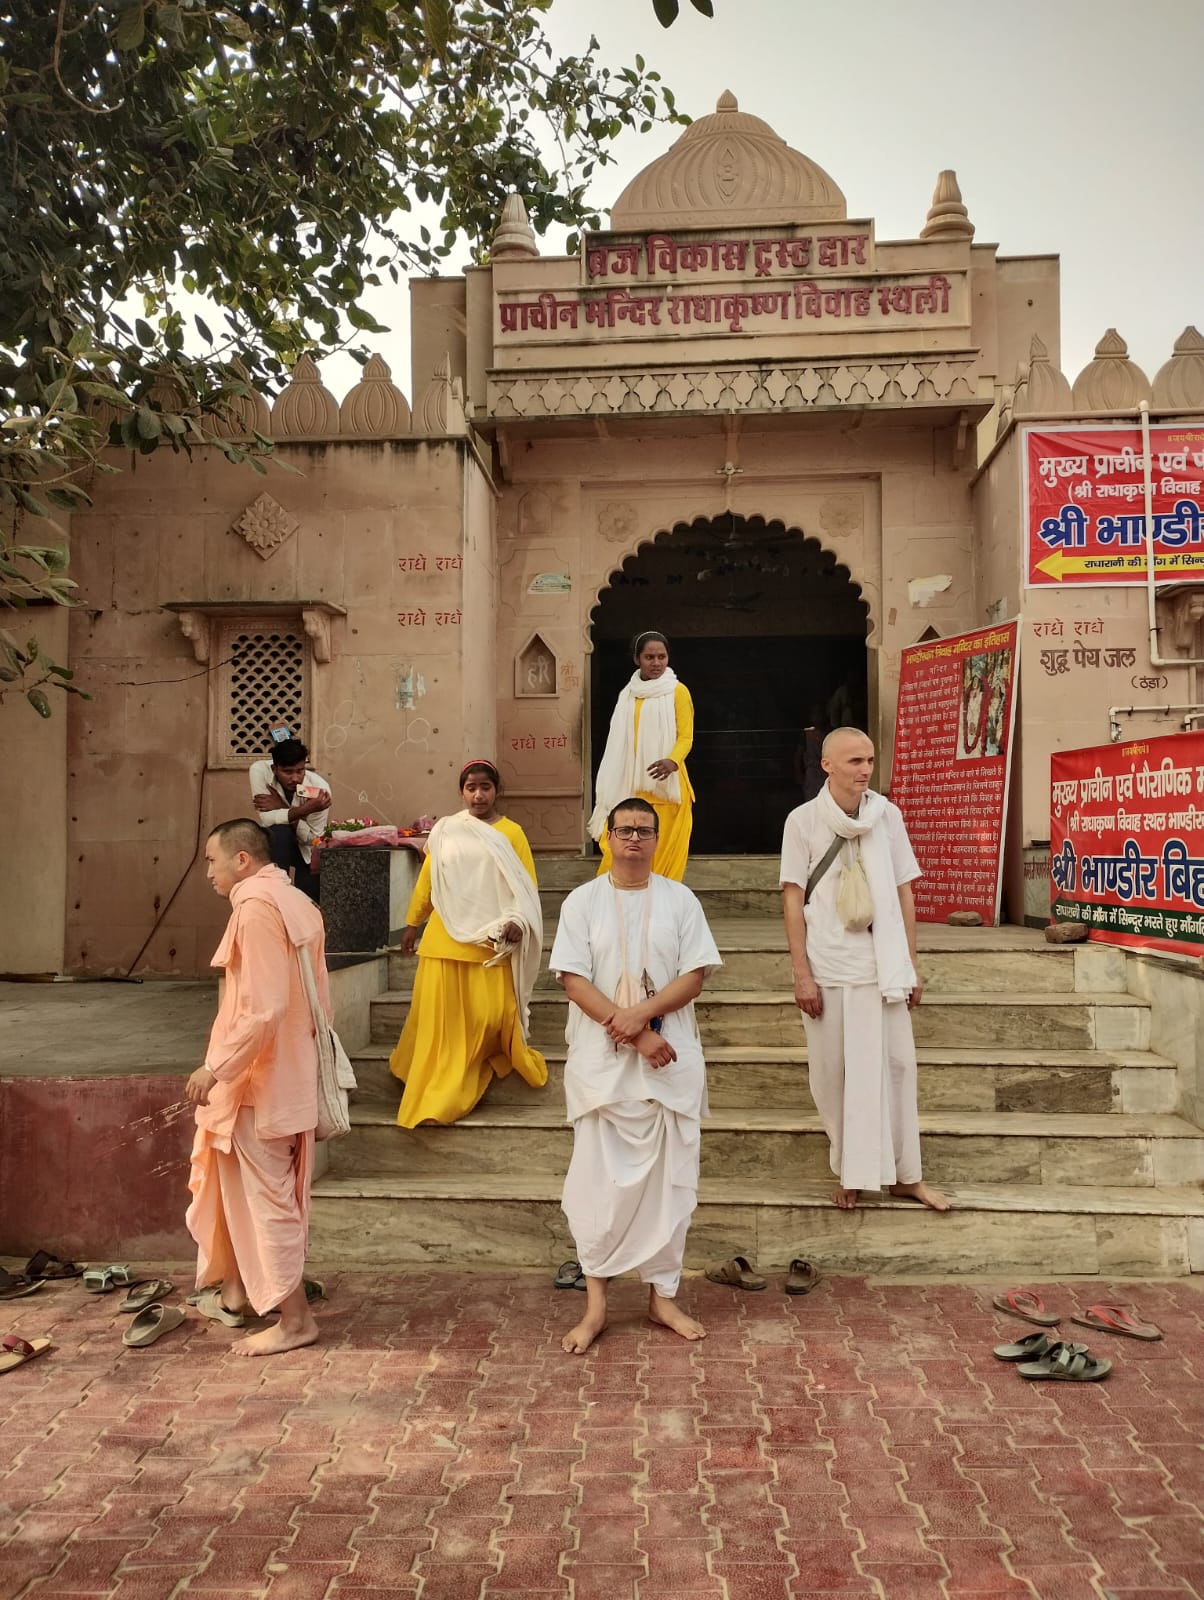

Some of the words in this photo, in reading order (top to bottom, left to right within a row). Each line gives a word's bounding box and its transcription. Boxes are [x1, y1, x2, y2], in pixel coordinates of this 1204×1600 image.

[588, 244, 640, 278] ब्रज
[648, 233, 748, 274] विकास
[753, 237, 811, 277] ट्रस्ट
[818, 234, 869, 267] द्वार
[500, 293, 578, 333] प्राचीन
[585, 289, 663, 328] मन्दिर
[667, 291, 792, 332] राधाकृष्ण
[794, 281, 873, 319] विवाह
[878, 276, 952, 315] स्थली
[1039, 456, 1089, 488] मुख्य
[1158, 446, 1189, 473] एवं
[1160, 477, 1201, 495] विवाह
[1038, 504, 1090, 548] श्री
[399, 554, 427, 572] राधे
[436, 554, 463, 571] राधे
[1084, 556, 1124, 568] राधारानी
[1127, 556, 1142, 567] की
[1169, 555, 1181, 566] में
[398, 608, 426, 626] राधे
[435, 609, 463, 626] राधे
[1033, 618, 1064, 637] राधे
[1074, 618, 1104, 636] राधे
[973, 639, 983, 649] का
[1072, 640, 1101, 668] पेय
[1104, 648, 1136, 668] जल
[512, 734, 536, 751] राधे
[544, 734, 568, 749] राधे
[1052, 780, 1078, 818] मुख्य
[1080, 767, 1113, 809] प्राचीन
[1116, 763, 1134, 802] एवं
[1081, 815, 1115, 839] राधाकृष्ण
[1117, 808, 1141, 832] विवाह
[1143, 812, 1166, 831] स्थल
[1051, 838, 1077, 892] श्री
[1081, 838, 1158, 901] भाण्डीर
[1056, 904, 1079, 919] राधारानी
[1082, 905, 1091, 920] की
[1093, 906, 1107, 923] माँग
[1109, 908, 1118, 924] में
[1118, 908, 1143, 932] सिन्दूर
[1145, 913, 1163, 930] भरते
[1165, 915, 1178, 937] हुए
